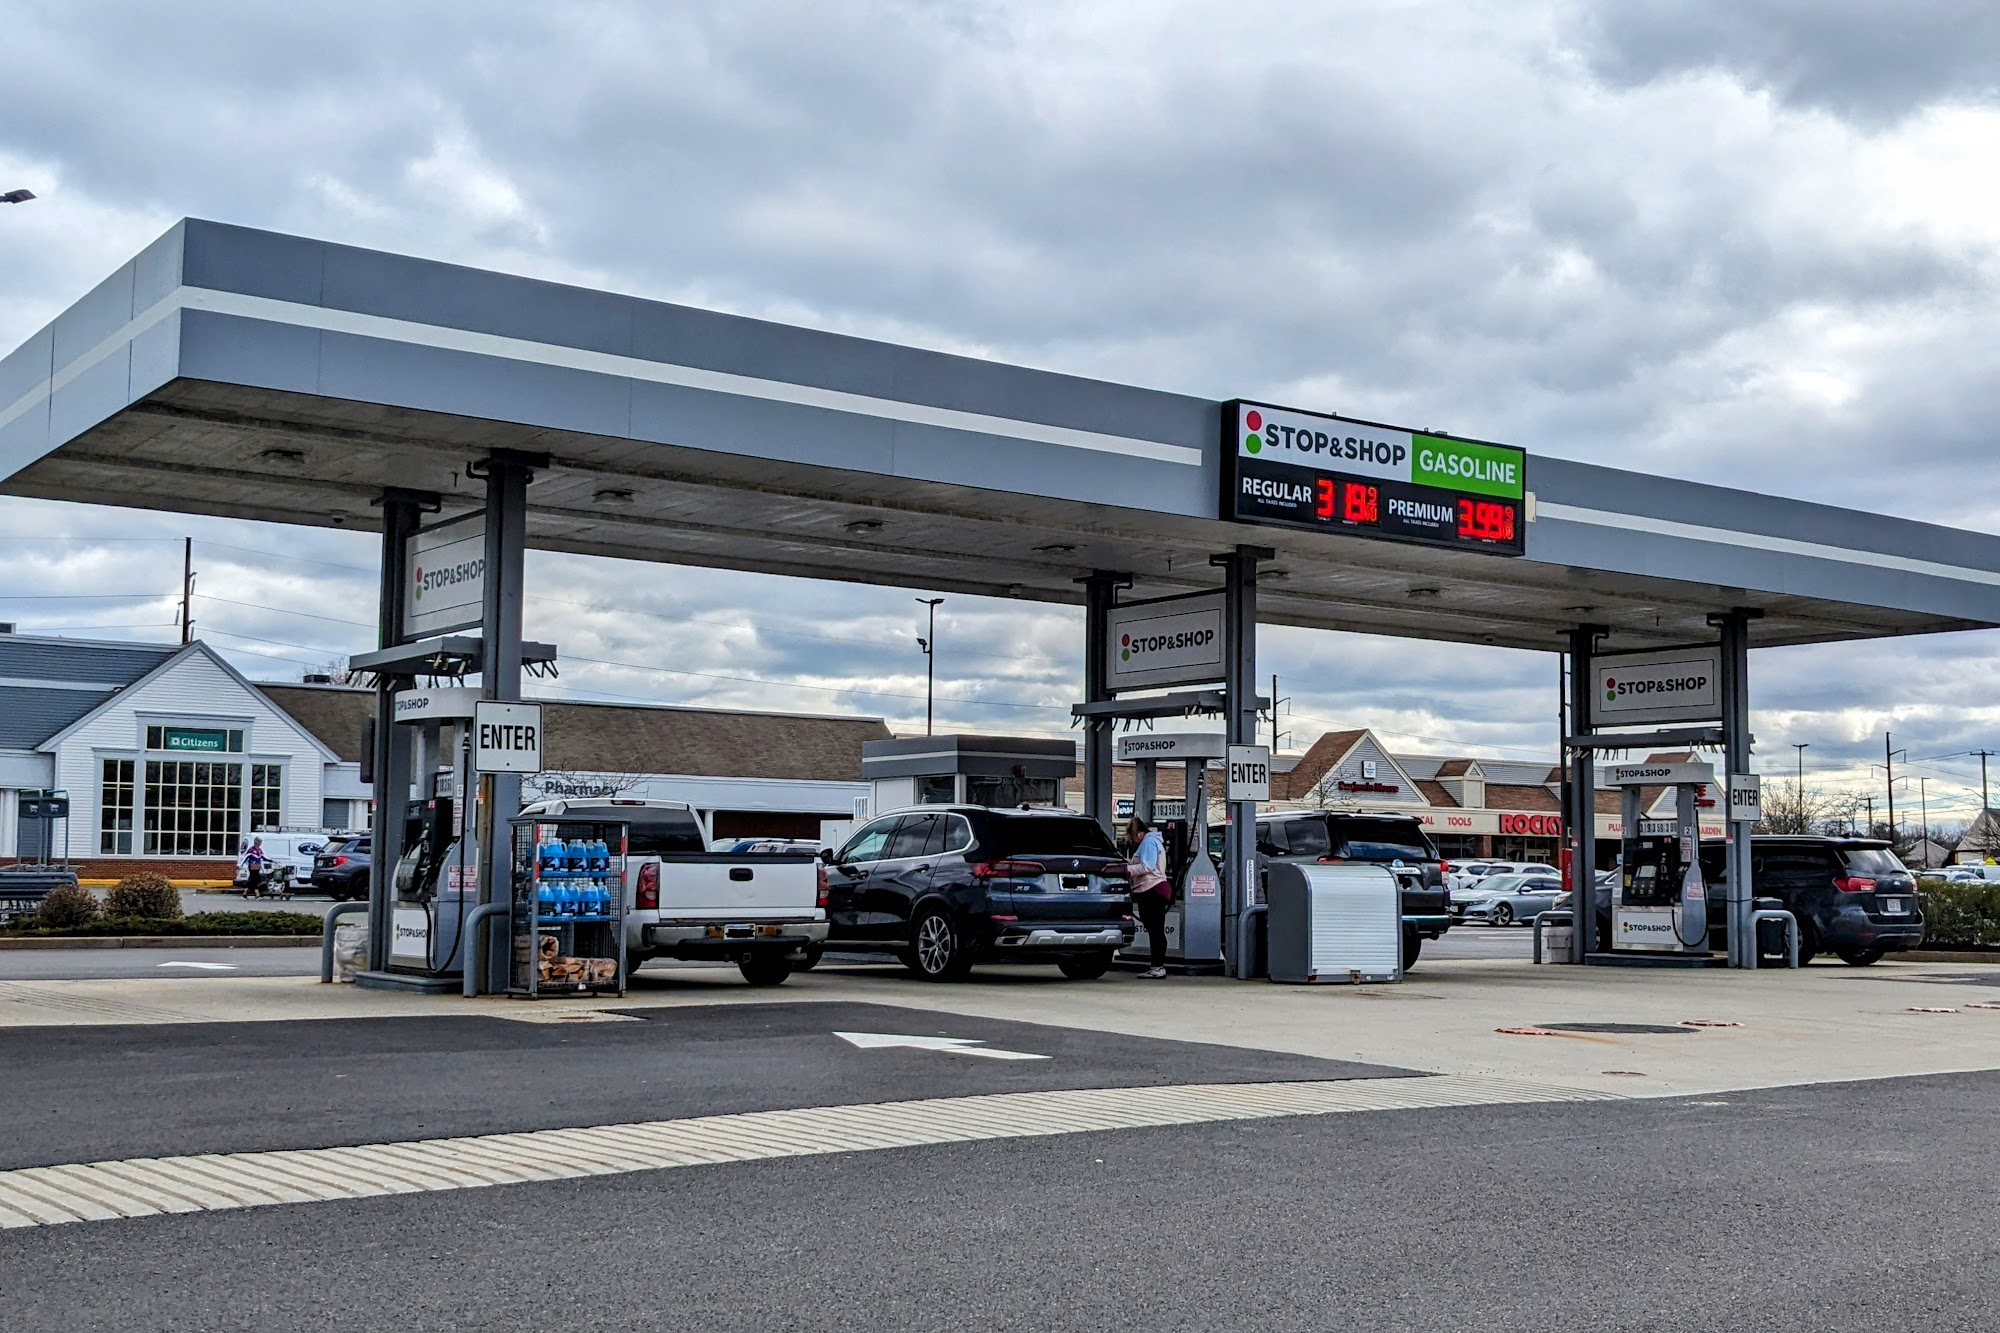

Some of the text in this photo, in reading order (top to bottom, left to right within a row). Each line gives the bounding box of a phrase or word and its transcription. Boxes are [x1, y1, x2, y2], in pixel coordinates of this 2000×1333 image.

[1265, 424, 1406, 466] STOP&SHOP
[1419, 449, 1515, 484] GASOLINE
[1242, 477, 1312, 503] REGULAR
[1388, 498, 1454, 523] PREMIUM
[423, 558, 485, 591] STOP&SHOP
[1131, 629, 1214, 654] STOP&SHOP
[1617, 676, 1707, 695] STOP&SHOP
[181, 737, 218, 748] Citizens
[480, 723, 536, 751] ENTER
[1128, 740, 1176, 751] STOP&SHOP
[1231, 762, 1267, 784] ENTER
[1620, 768, 1671, 778] STOP&SHOP
[545, 780, 618, 798] Pharmacy
[1733, 789, 1758, 807] ENTER
[1447, 816, 1472, 827] TOOLS
[1700, 826, 1722, 835] ARDEN
[400, 927, 427, 939] STOP&SHO
[1628, 924, 1672, 932] STOP&SHOP
